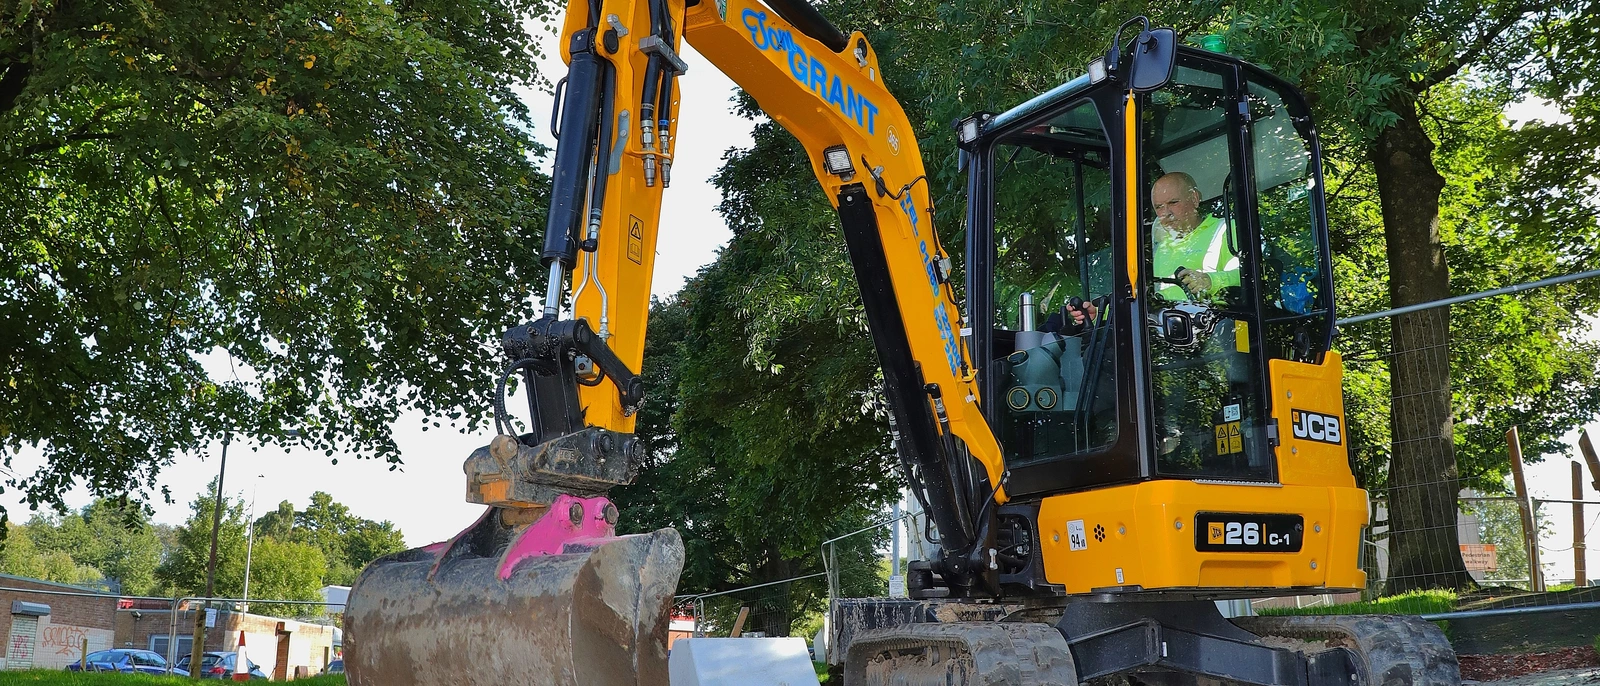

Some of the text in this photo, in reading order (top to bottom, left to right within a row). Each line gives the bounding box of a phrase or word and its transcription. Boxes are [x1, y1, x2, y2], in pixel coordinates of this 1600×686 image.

[741, 8, 879, 136] Tom GRANT
[1293, 412, 1341, 443] JCB
[1070, 533, 1081, 548] 94
[1225, 522, 1260, 545] 26
